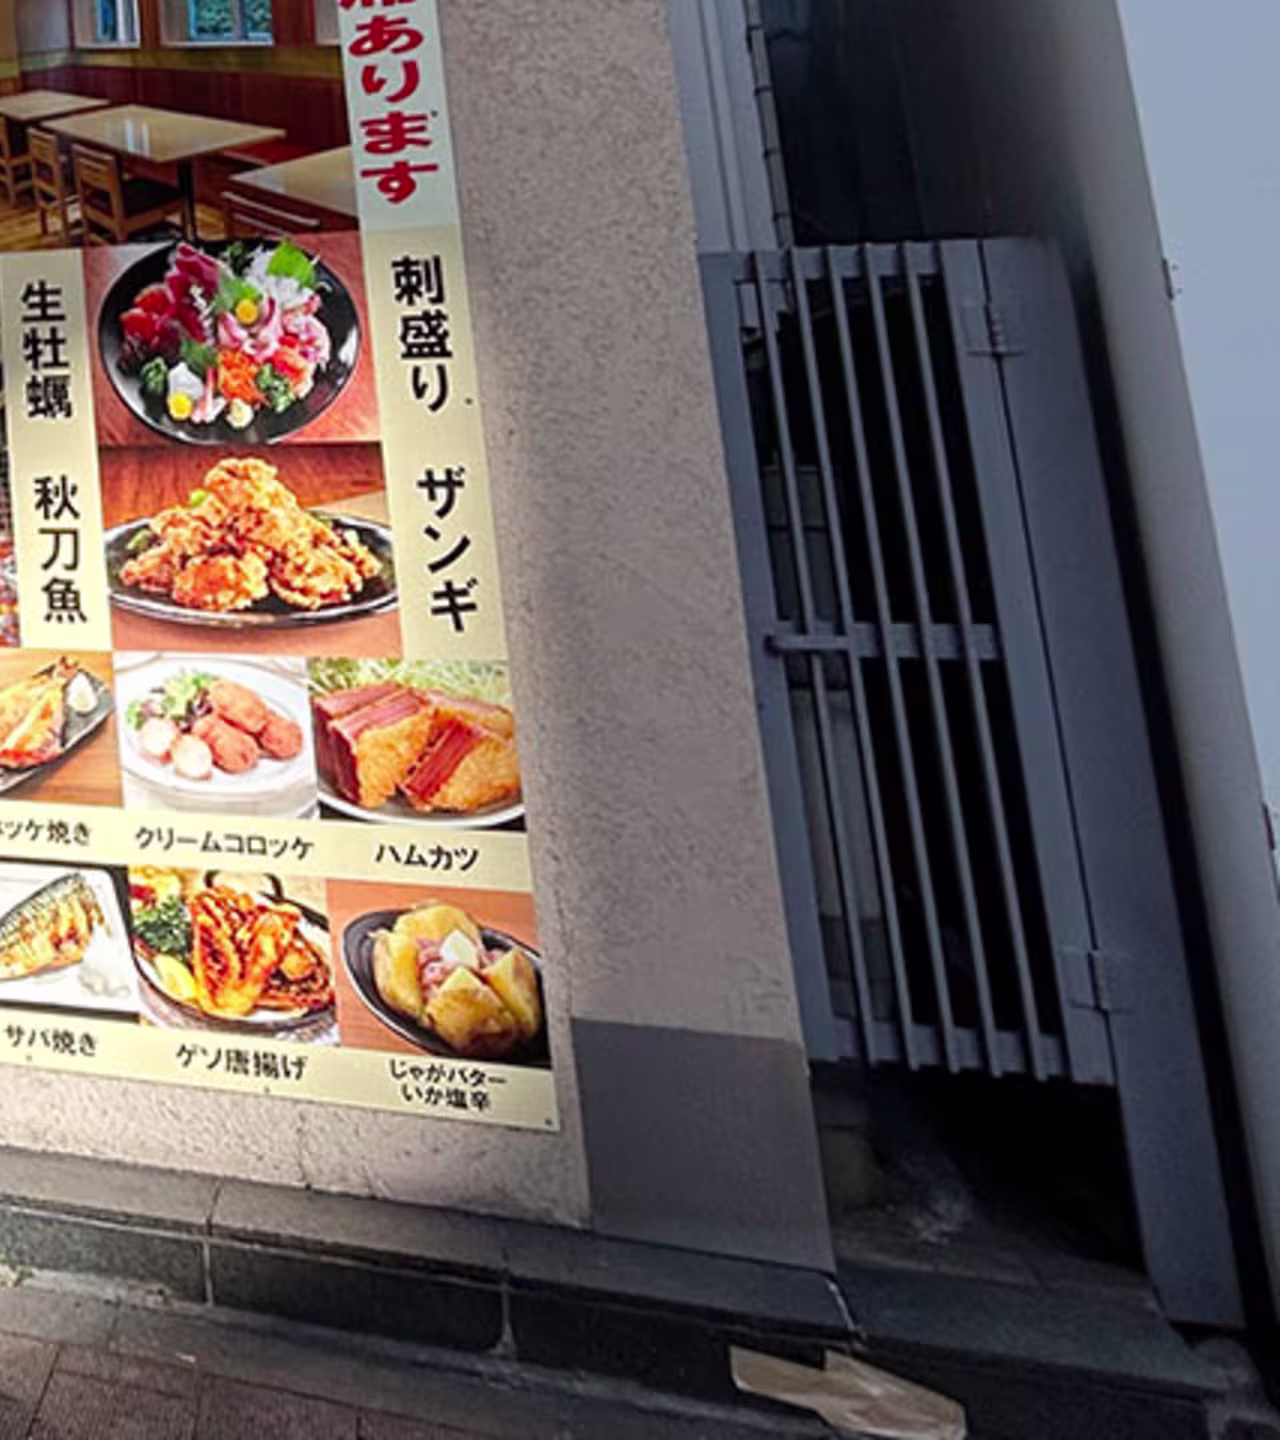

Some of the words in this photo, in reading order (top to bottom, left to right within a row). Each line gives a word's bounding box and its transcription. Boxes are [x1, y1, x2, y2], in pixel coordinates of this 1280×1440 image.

[21, 280, 74, 421] 生牡蠣
[391, 256, 452, 413] 刺盛り
[34, 476, 88, 625] 秋刀魚
[418, 466, 479, 633] ザンギ
[134, 826, 315, 860] クリームコロッケ
[376, 844, 480, 873] ハムカツ
[4, 1024, 97, 1057] サバ焼き
[176, 1043, 309, 1081] ゲソ唐揚げ
[388, 1059, 507, 1086] じゃがバター
[401, 1082, 492, 1111] いか塩辛
